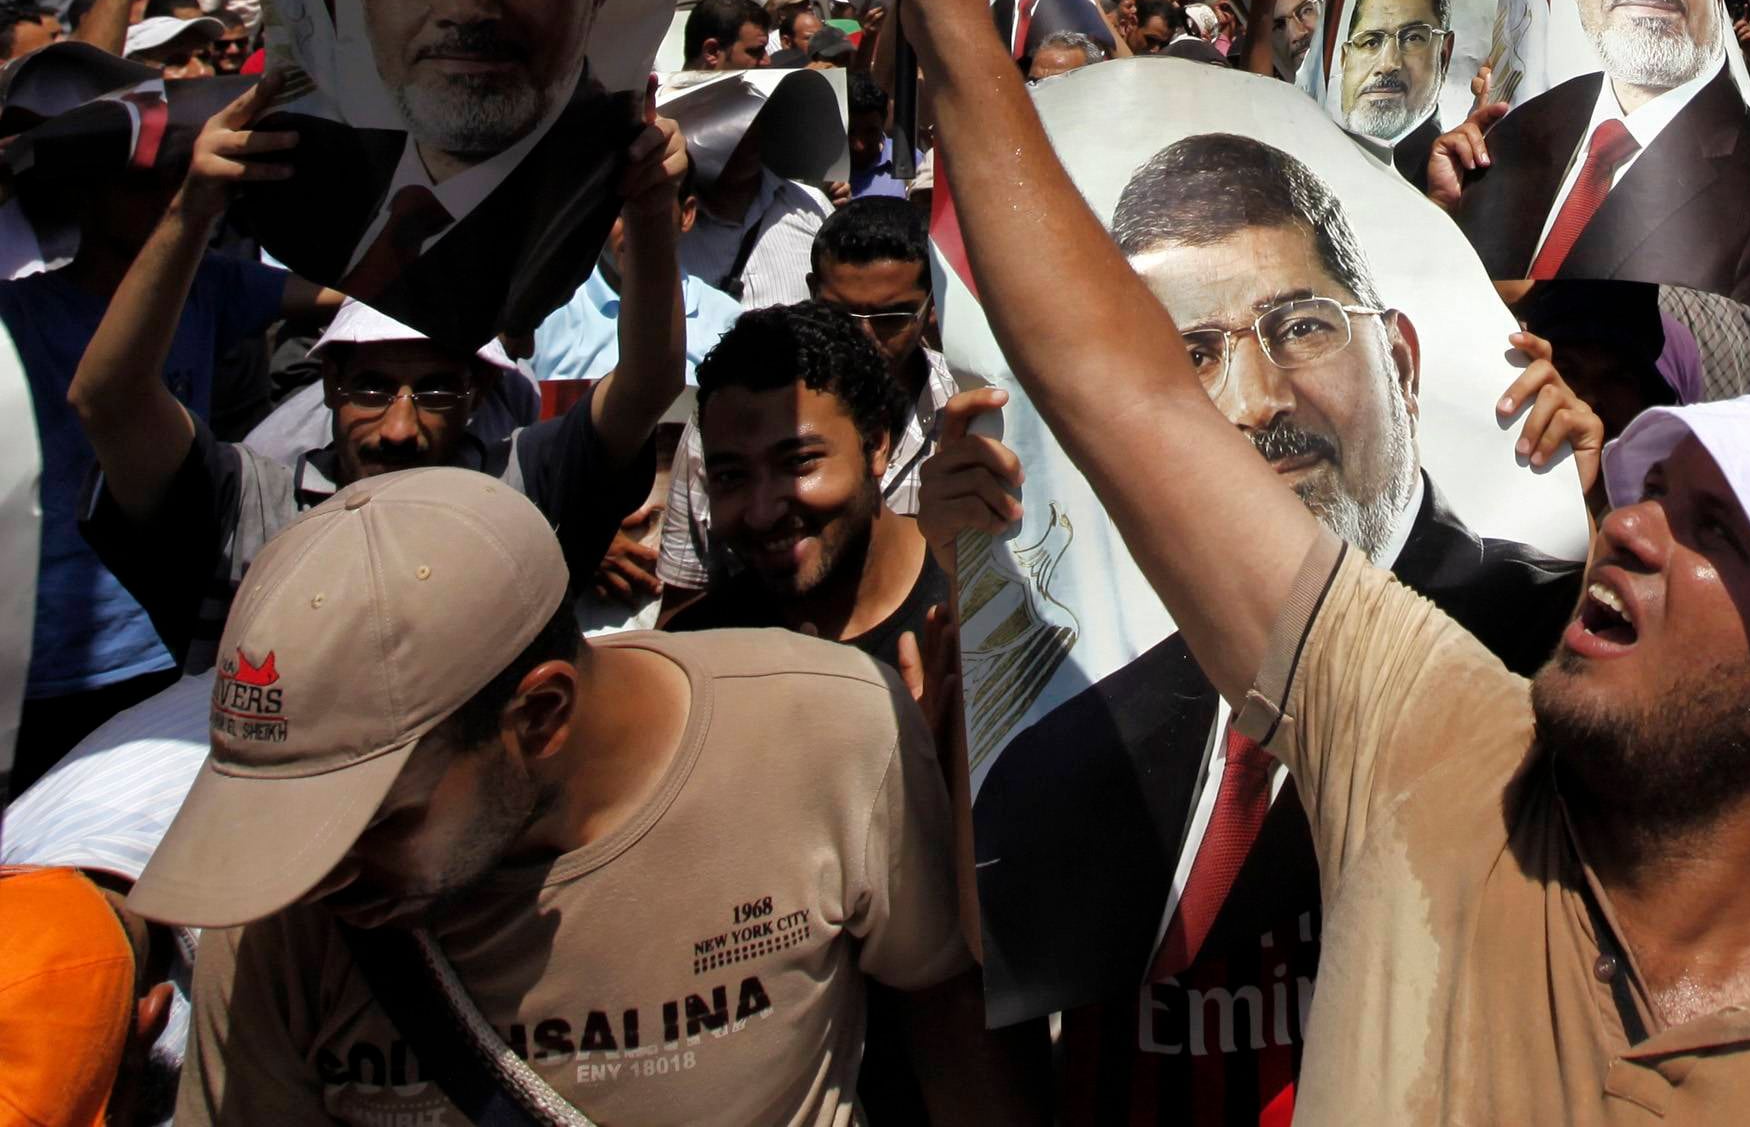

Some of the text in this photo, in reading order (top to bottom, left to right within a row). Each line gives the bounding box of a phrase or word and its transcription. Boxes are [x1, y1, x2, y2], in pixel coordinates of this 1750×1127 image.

[733, 896, 773, 924] 1968
[694, 909, 810, 956] NEW YORK CITY
[576, 1063, 622, 1083] ENY
[629, 1050, 698, 1078] 18018
